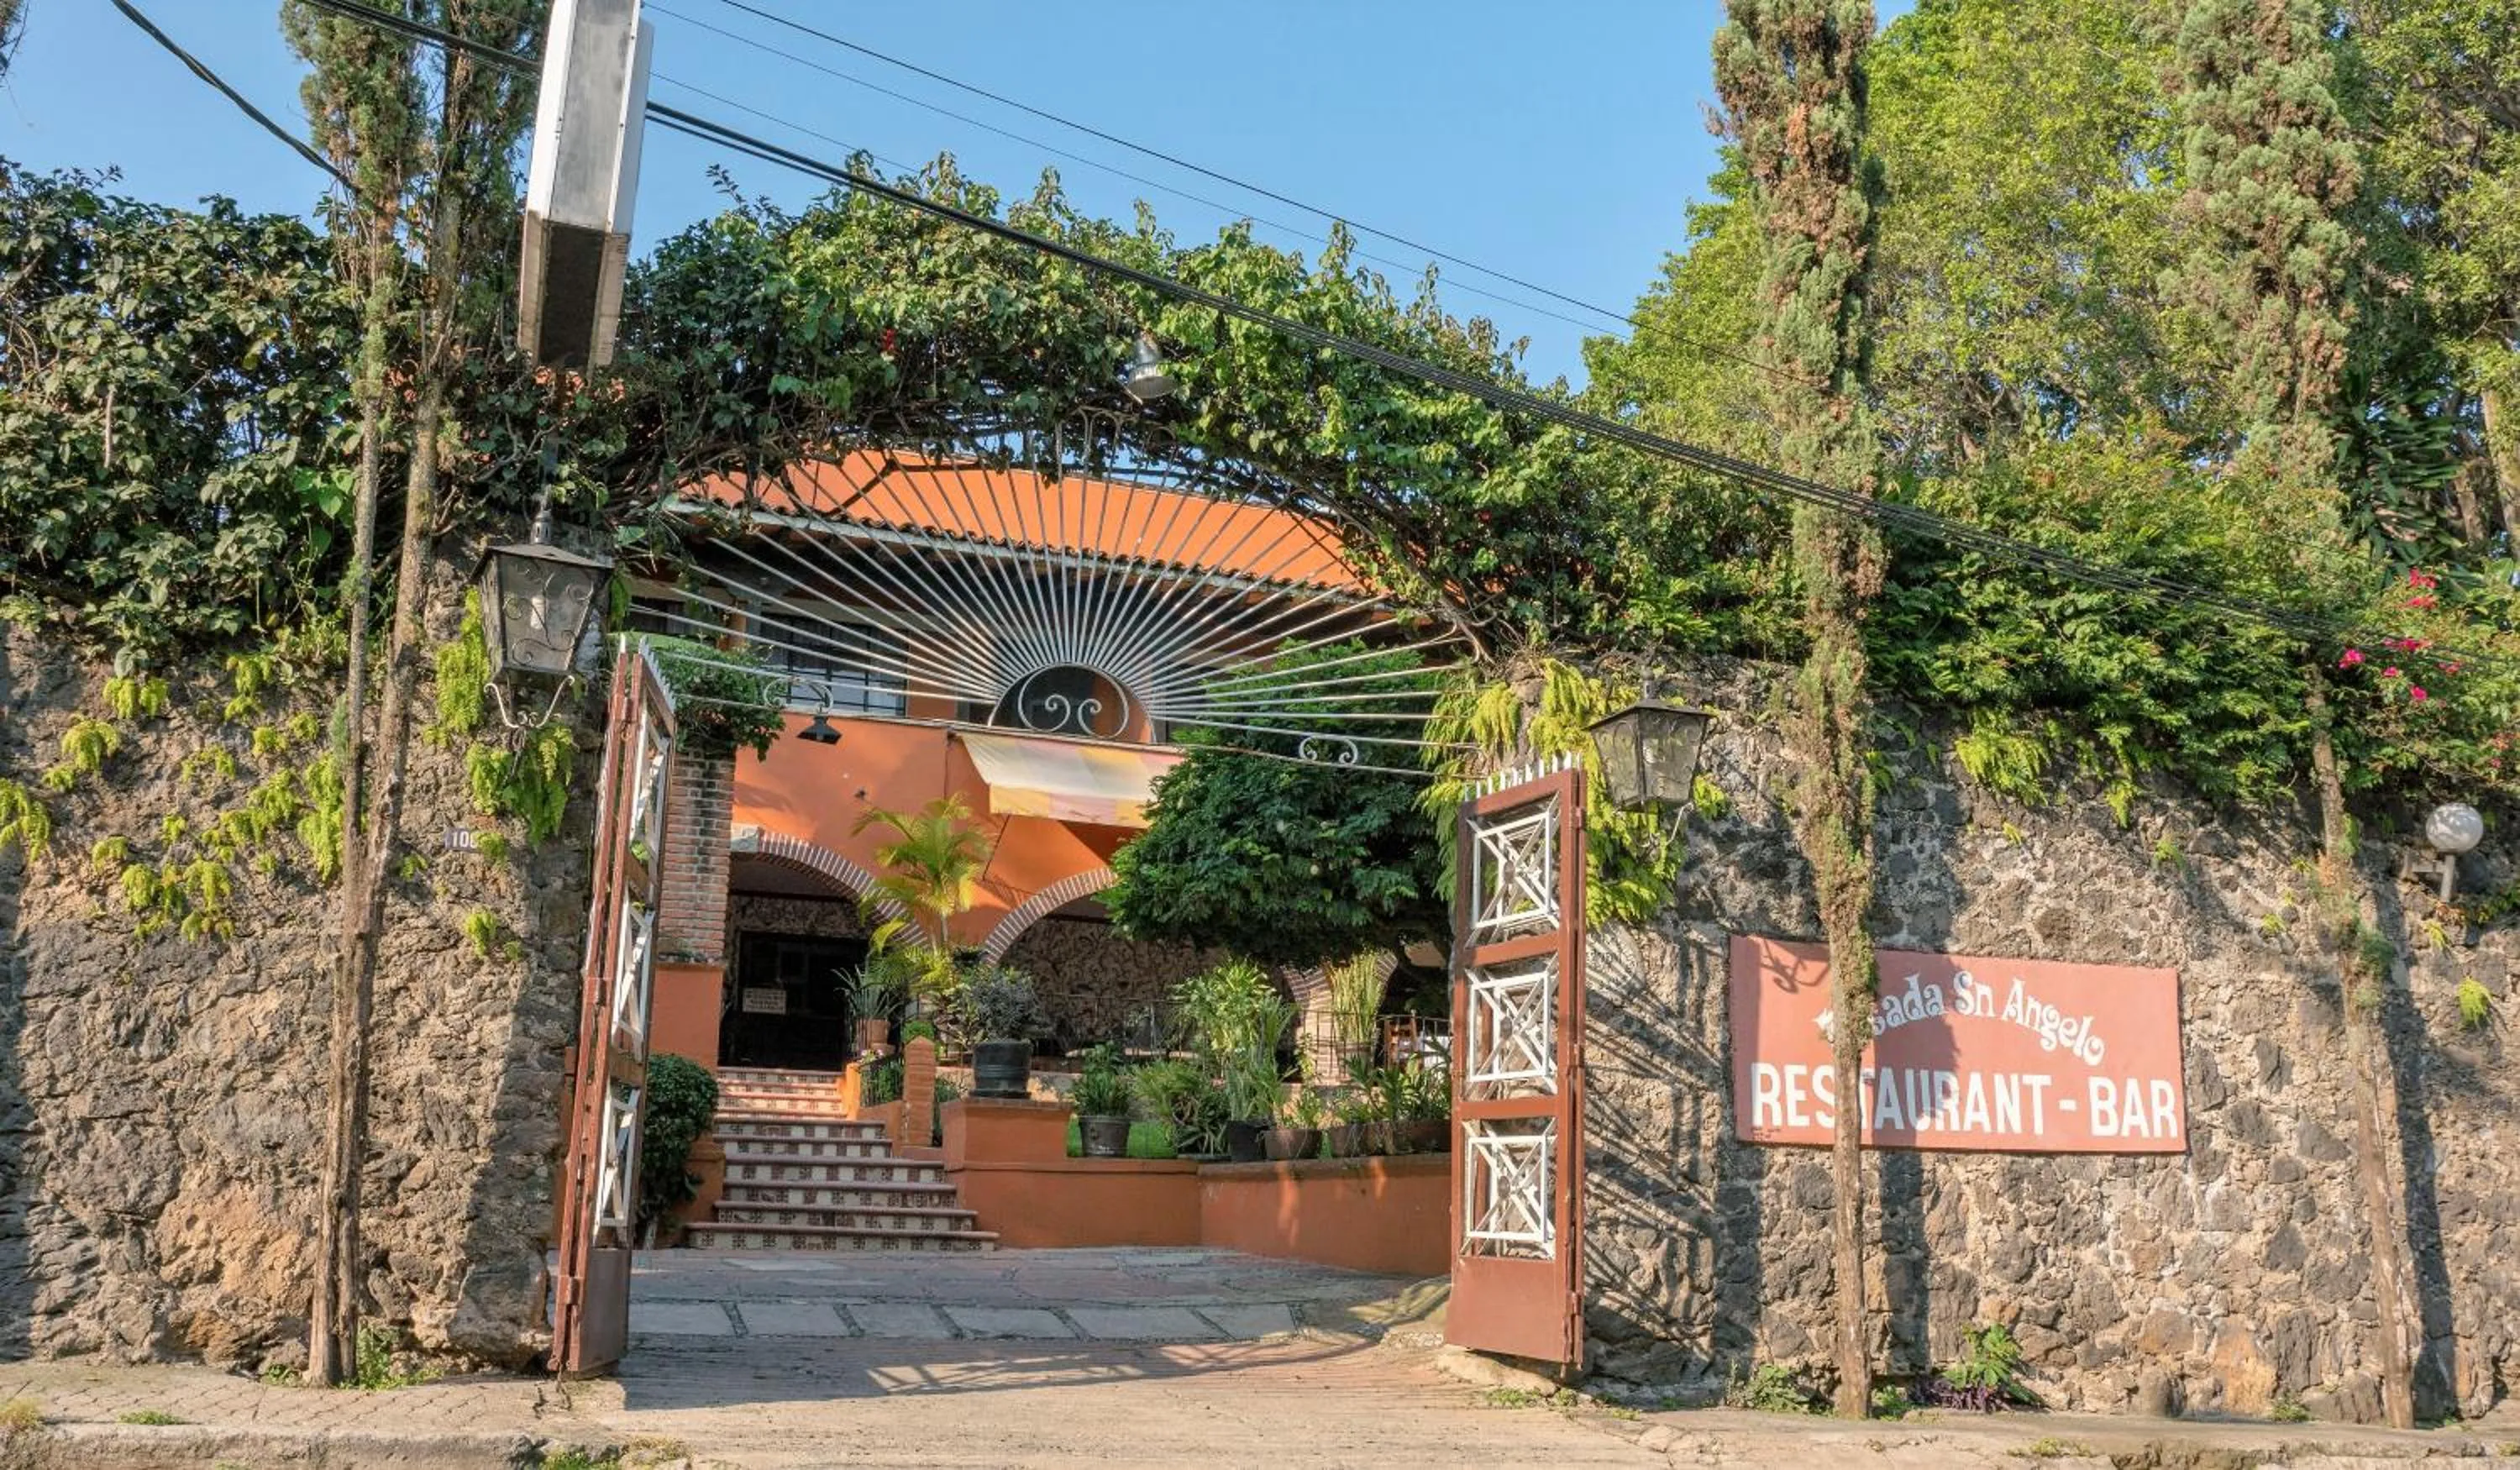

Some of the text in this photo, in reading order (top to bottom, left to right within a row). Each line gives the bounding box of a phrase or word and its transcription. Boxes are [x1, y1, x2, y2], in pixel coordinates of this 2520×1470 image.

[1812, 970, 2106, 1066] sada Sn Angelo
[1751, 1061, 2178, 1138] RESTAURANT - BAR
